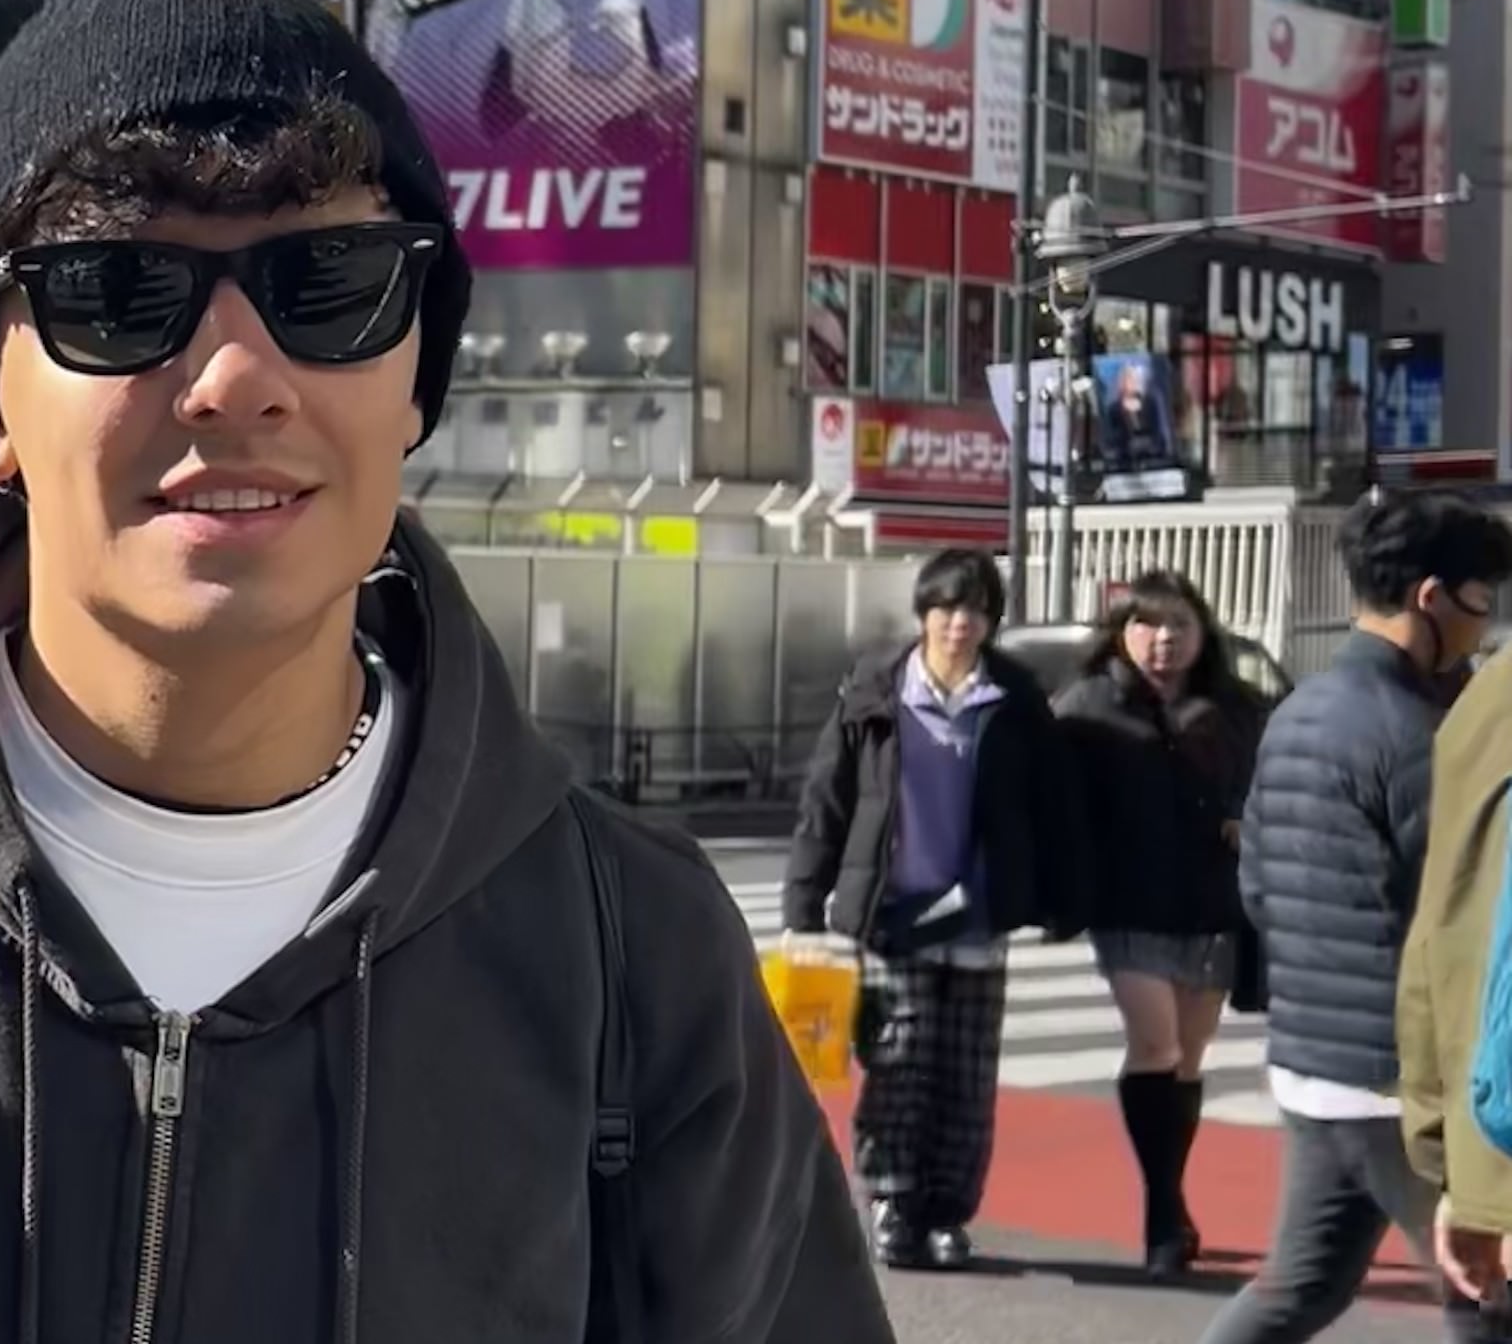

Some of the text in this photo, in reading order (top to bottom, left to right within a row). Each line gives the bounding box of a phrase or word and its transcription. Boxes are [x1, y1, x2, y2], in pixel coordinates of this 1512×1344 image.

[826, 83, 970, 150] サンドラッグ
[1266, 95, 1356, 172] アコム
[1208, 261, 1343, 352] LUSH
